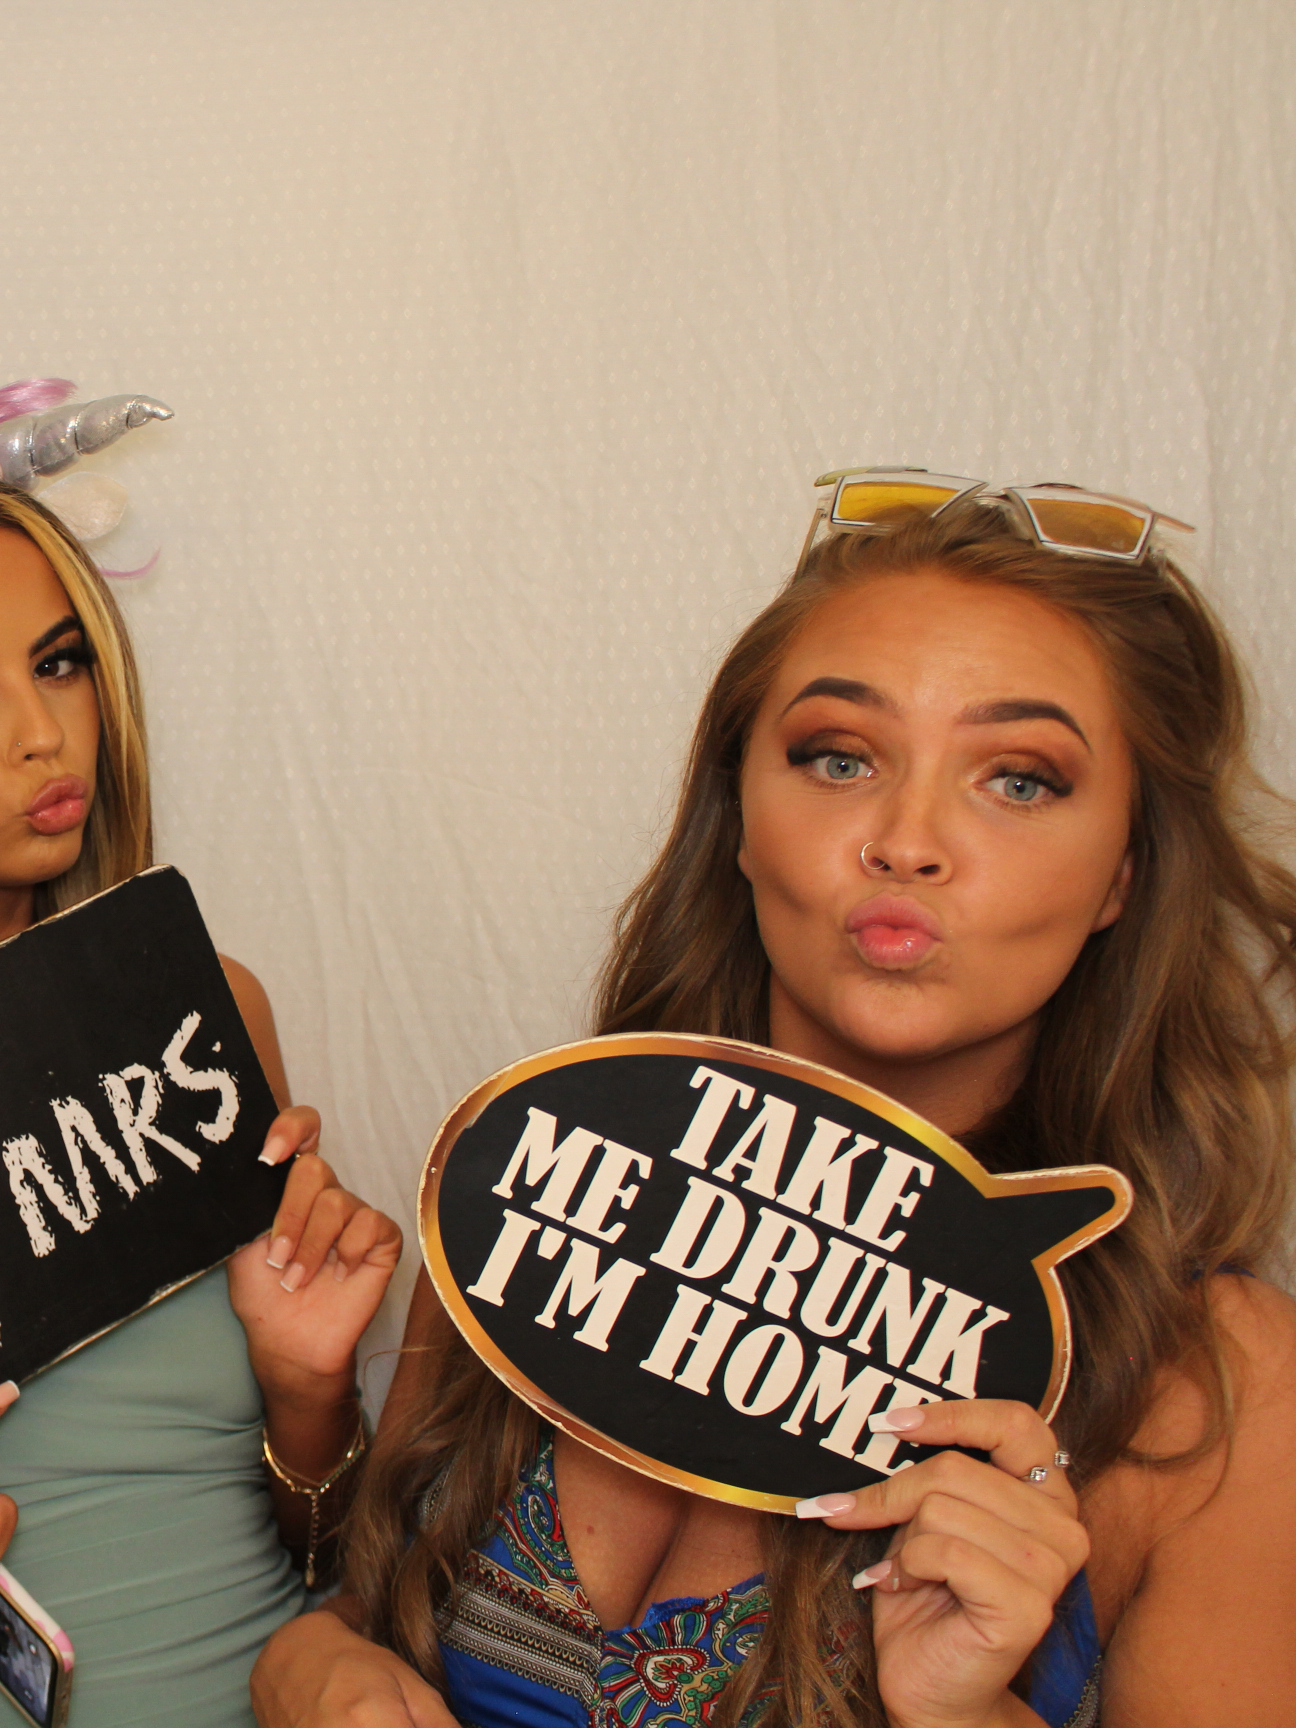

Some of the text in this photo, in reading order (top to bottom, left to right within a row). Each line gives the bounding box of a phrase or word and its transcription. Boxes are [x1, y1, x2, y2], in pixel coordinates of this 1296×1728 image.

[2, 1010, 241, 1258] MRS
[670, 1065, 934, 1252] TAKE
[466, 1208, 646, 1352] I'M
[492, 1106, 1010, 1400] ME DRUNK
